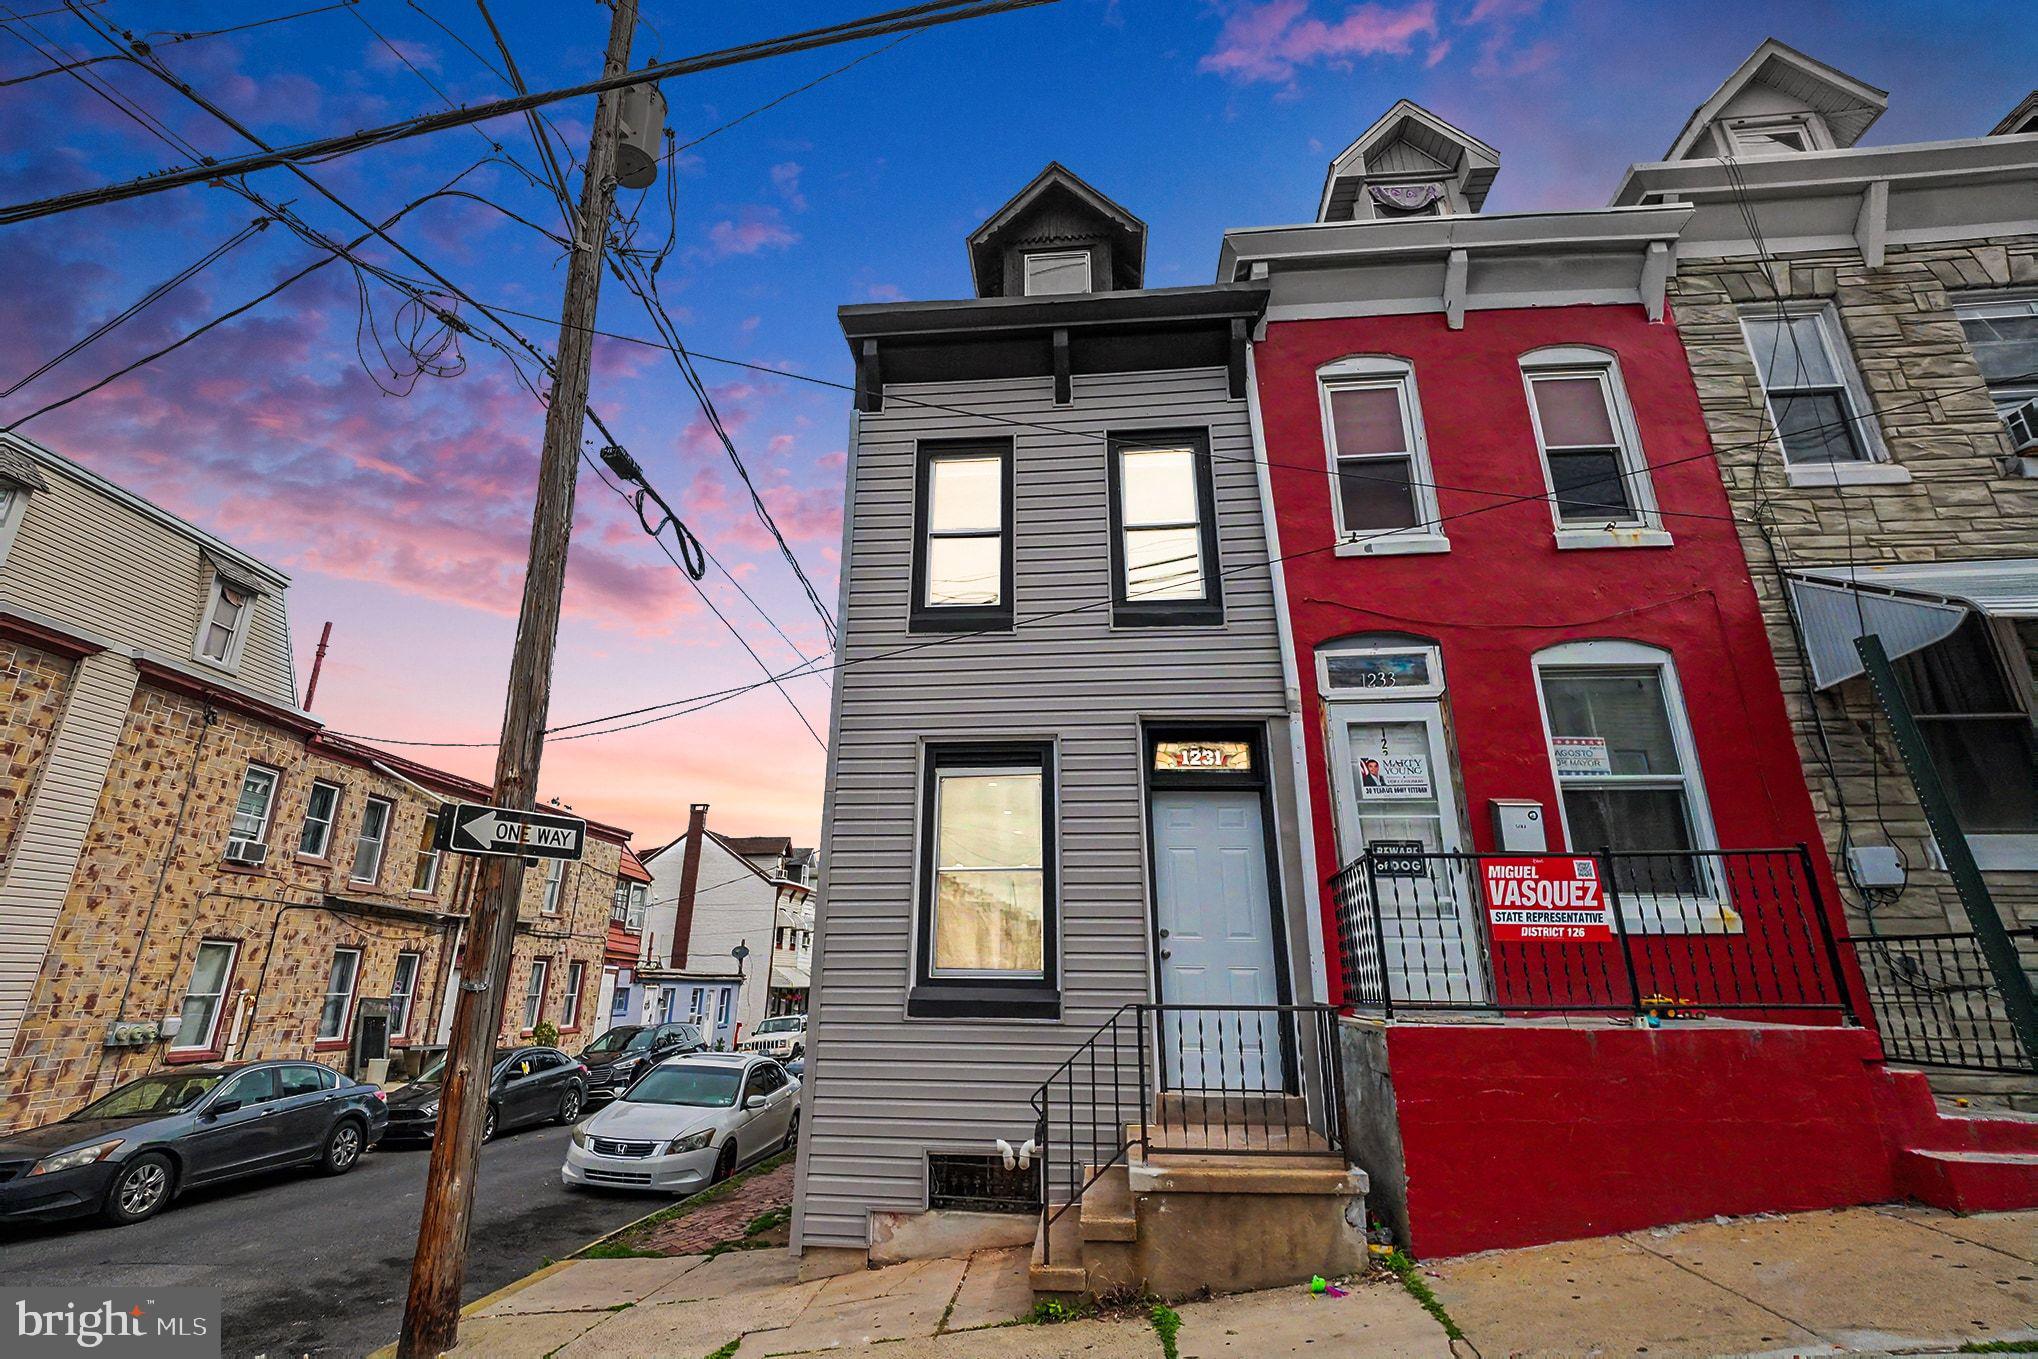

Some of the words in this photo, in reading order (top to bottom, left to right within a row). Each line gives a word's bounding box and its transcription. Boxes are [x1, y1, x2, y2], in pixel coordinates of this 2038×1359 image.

[1361, 672, 1396, 688] 1233
[1181, 748, 1222, 766] 1231
[1382, 758, 1422, 767] MARTY
[1570, 759, 1601, 767] MAYOR
[1384, 767, 1423, 775] YOUNG
[496, 823, 532, 843] ONE
[537, 829, 572, 847] WAY
[1377, 861, 1389, 870] of
[1391, 861, 1421, 871] DOG
[1488, 865, 1539, 879] MIGUEL
[1489, 880, 1598, 909] VASQUEZ
[1495, 911, 1523, 923] STATE
[1525, 912, 1604, 923] REPRESENTATIVE
[1521, 926, 1565, 937] DISTRICT
[1567, 927, 1585, 937] 126
